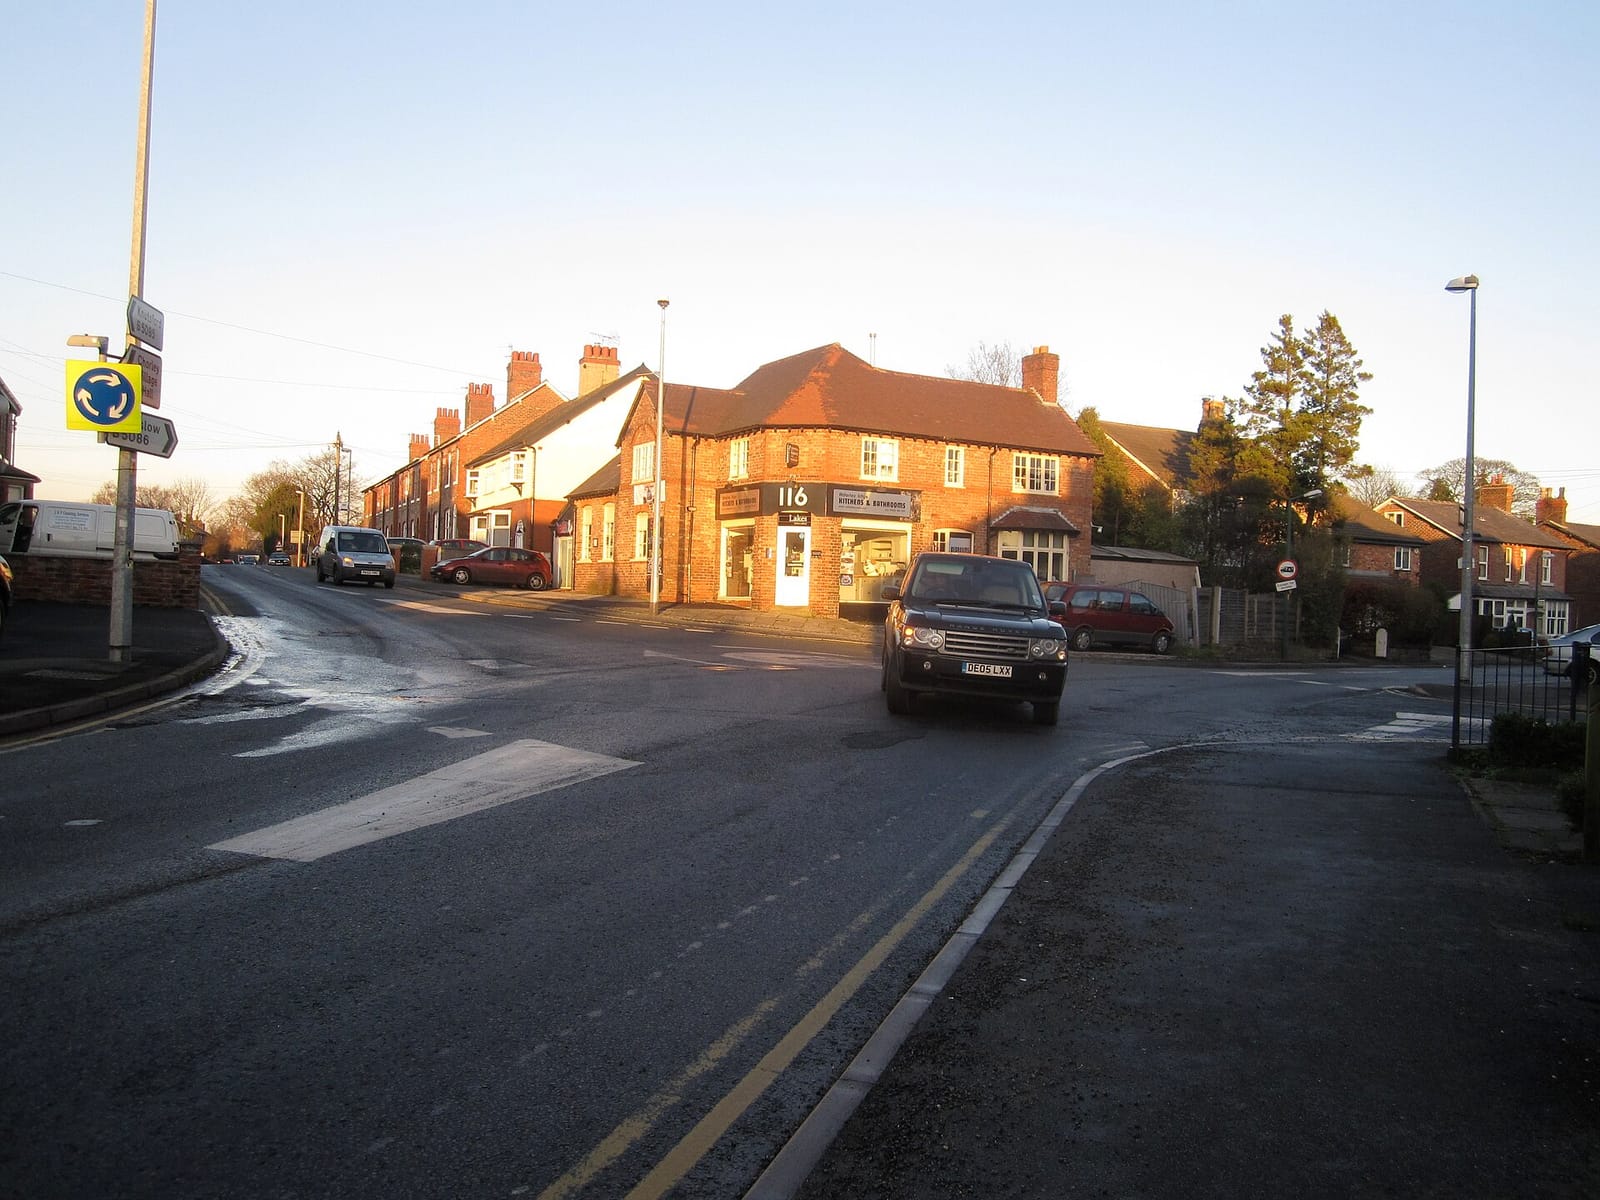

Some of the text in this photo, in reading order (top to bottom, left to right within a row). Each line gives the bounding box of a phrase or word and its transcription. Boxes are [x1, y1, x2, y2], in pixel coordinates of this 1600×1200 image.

[779, 486, 808, 506] 116
[838, 497, 864, 506] KITCHENS
[872, 500, 906, 509] BATHROOMS
[967, 663, 1011, 676] DE05 LXX
